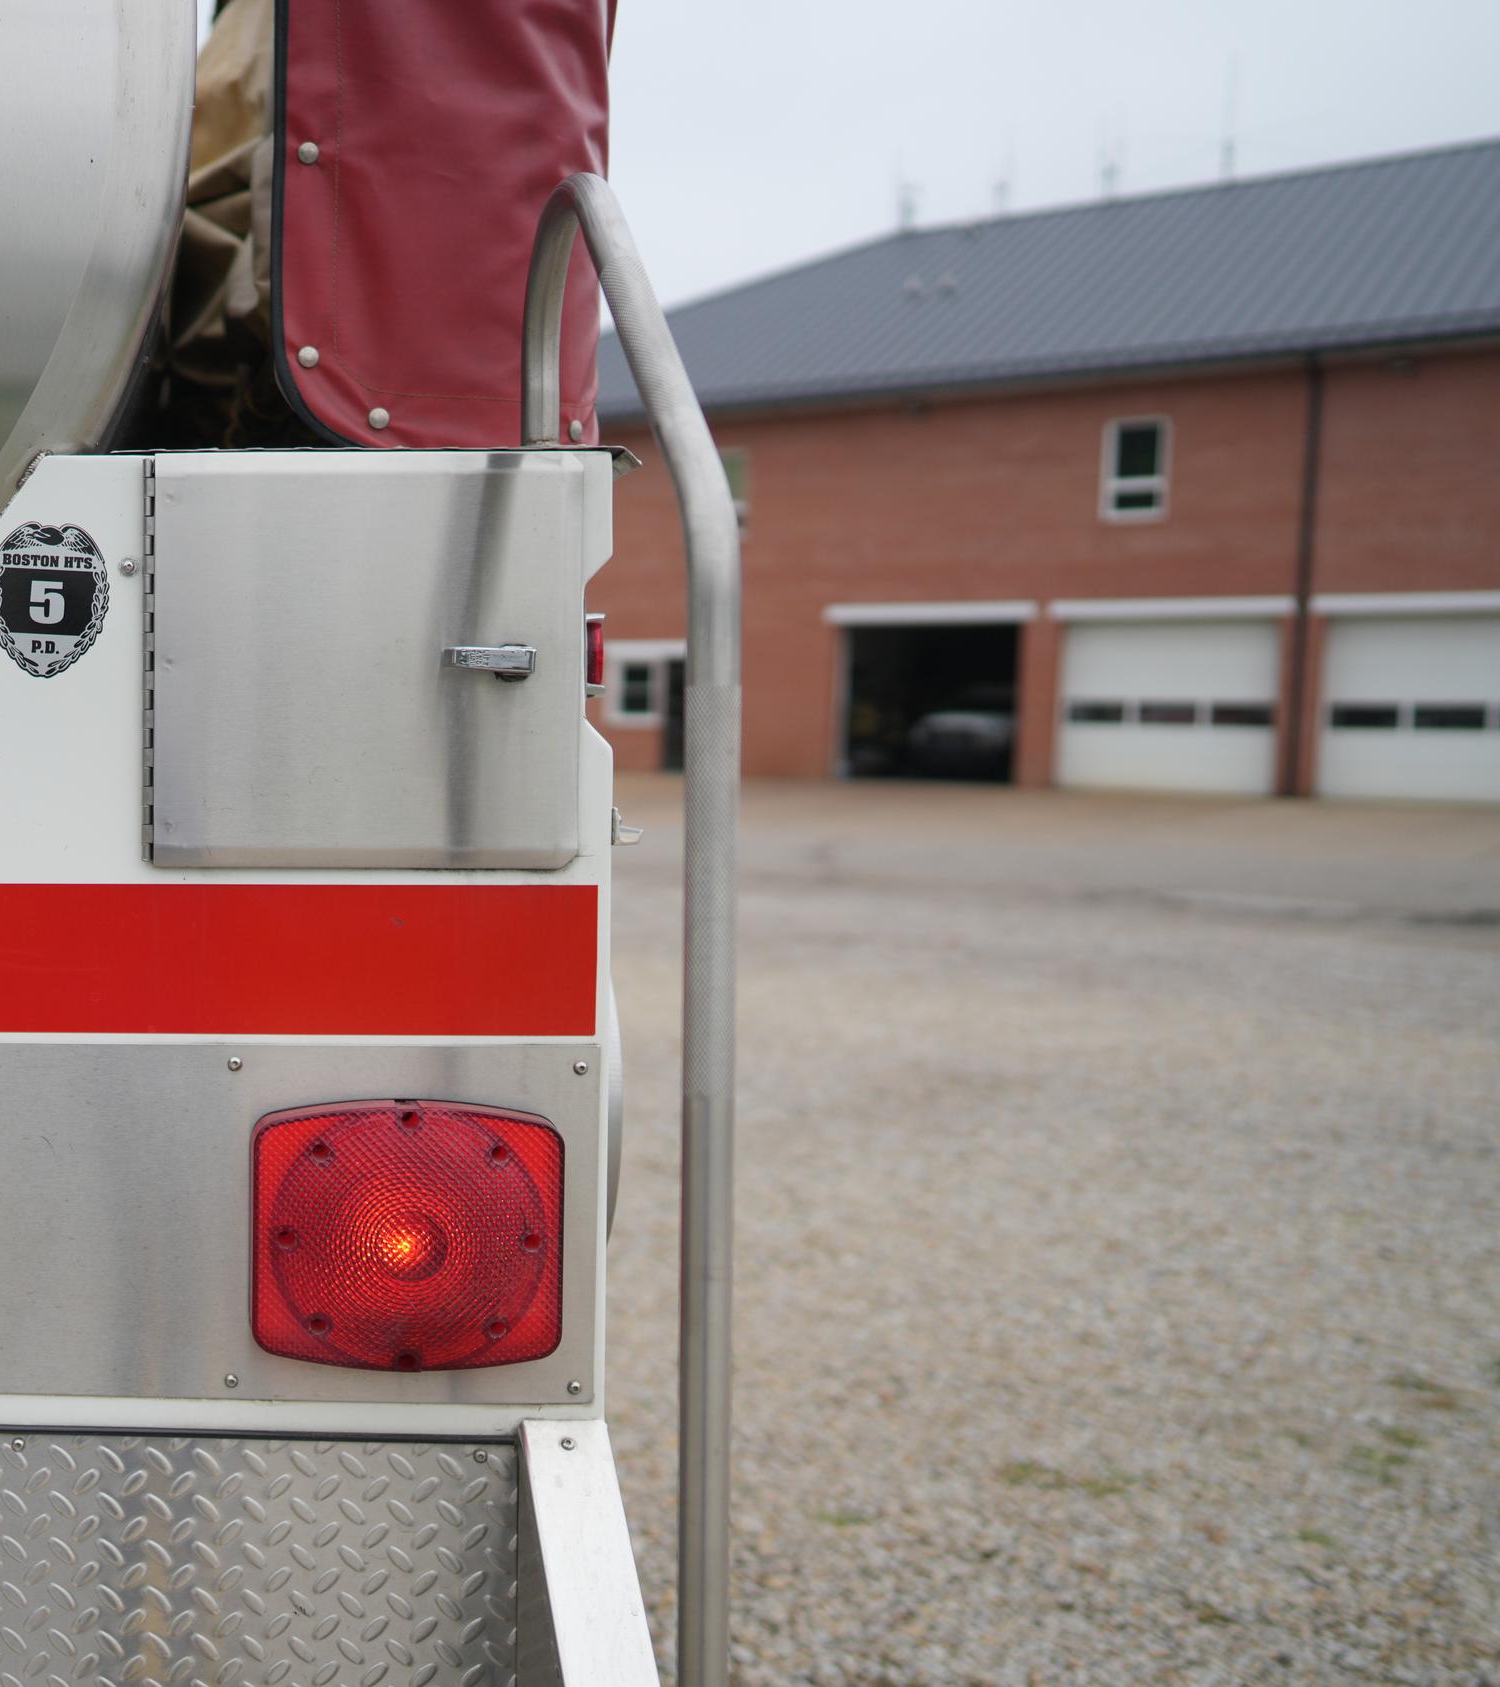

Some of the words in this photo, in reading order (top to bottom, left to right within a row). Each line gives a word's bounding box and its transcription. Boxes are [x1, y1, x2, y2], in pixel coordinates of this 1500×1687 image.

[2, 553, 59, 568] BOSTON
[64, 556, 96, 570] HTS.
[29, 580, 65, 625] 5
[31, 640, 60, 654] P.D.
